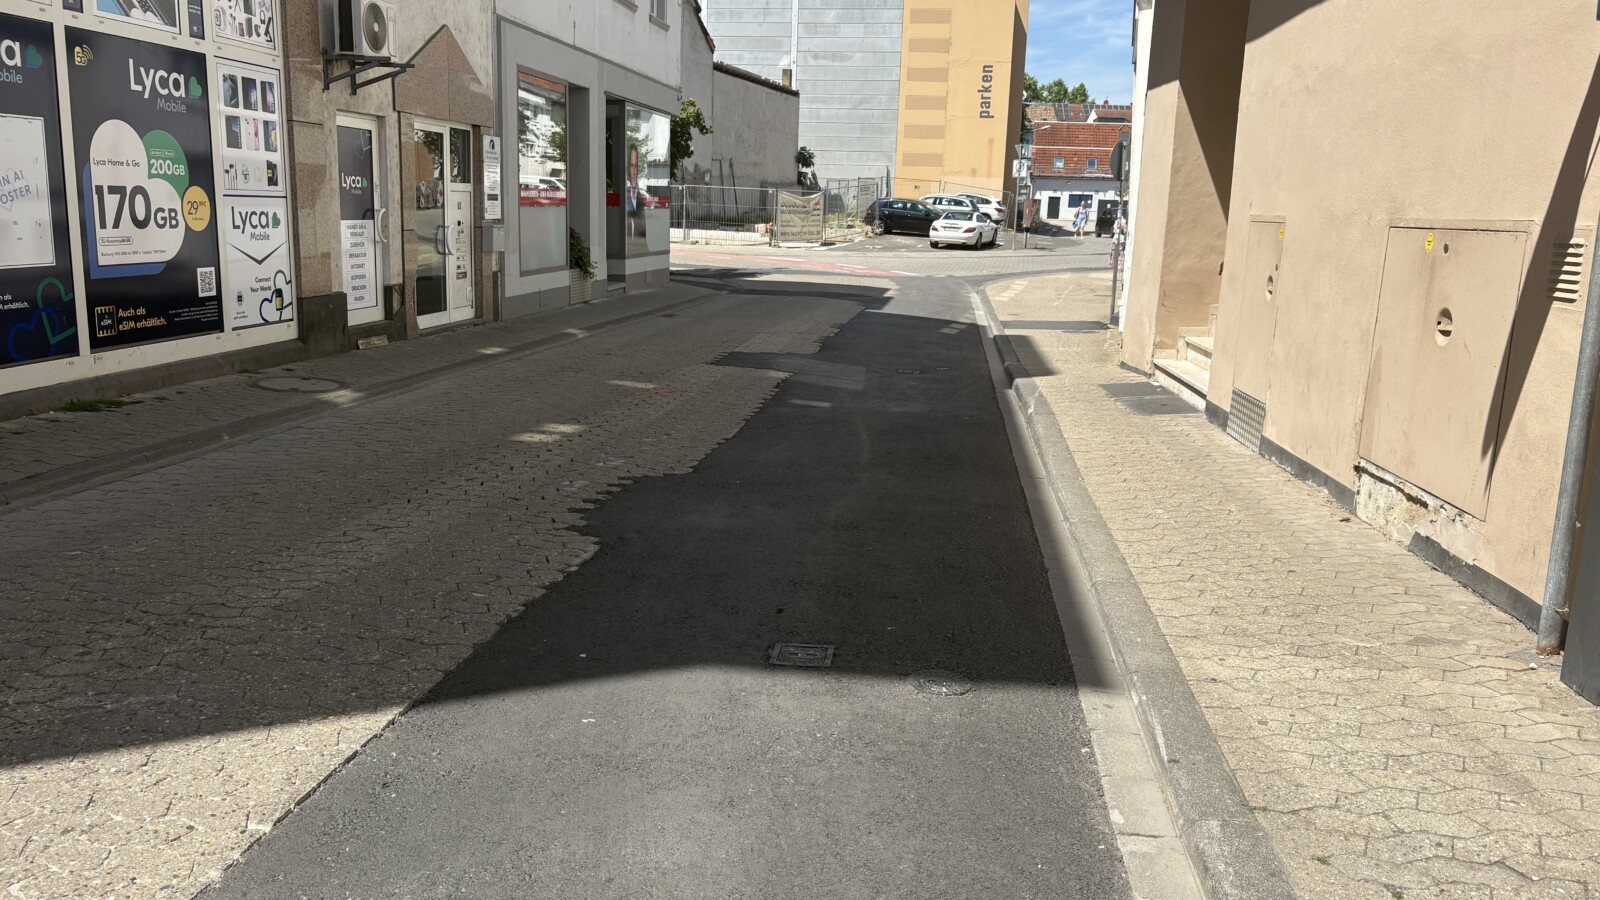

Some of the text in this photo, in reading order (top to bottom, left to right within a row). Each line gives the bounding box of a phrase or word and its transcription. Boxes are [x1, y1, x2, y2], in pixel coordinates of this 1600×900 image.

[76, 51, 87, 65] 5G
[129, 58, 186, 99] Lyca
[977, 64, 994, 119] parken
[157, 97, 187, 114] Mobile
[93, 157, 141, 168] Lyca Home & Go
[341, 172, 362, 190] Lyca
[231, 206, 269, 234] Lyca
[250, 231, 270, 241] Mobile
[254, 276, 272, 284] Connect
[117, 306, 146, 318] Auch als
[100, 318, 112, 326] eSIM
[118, 317, 167, 331] eSIM erhältlich.
